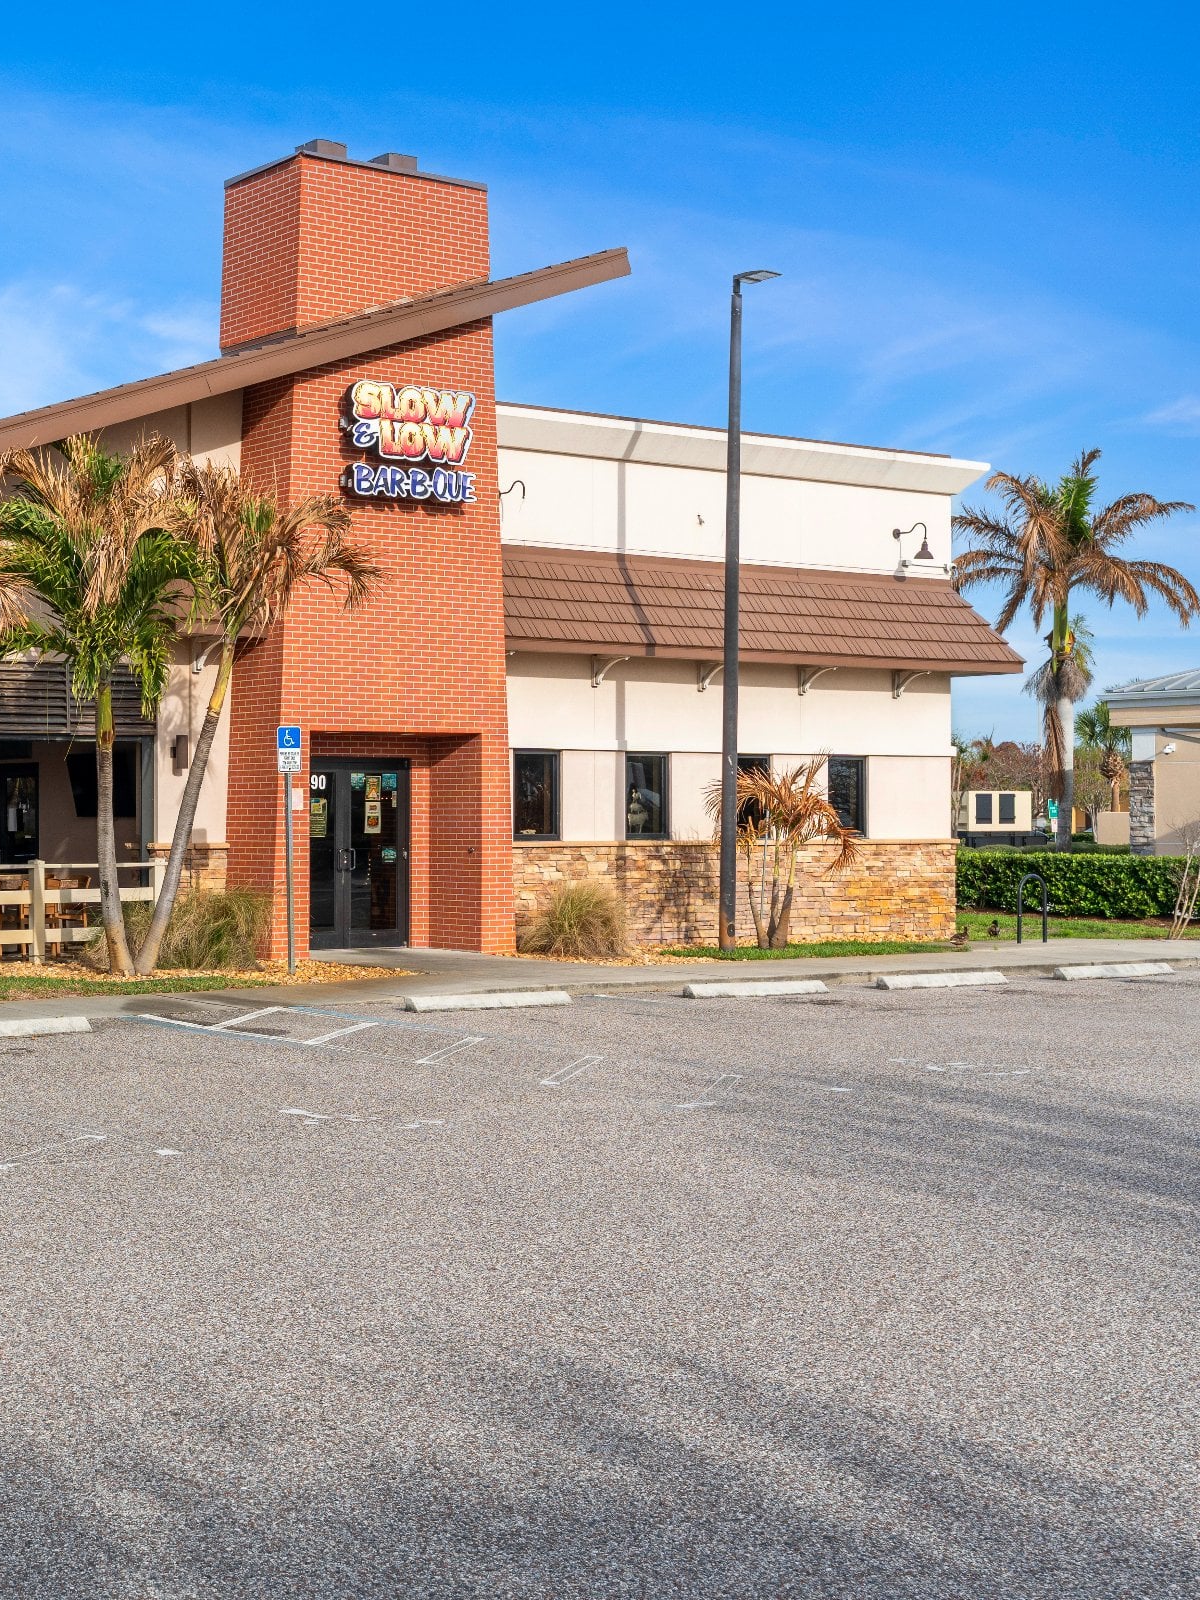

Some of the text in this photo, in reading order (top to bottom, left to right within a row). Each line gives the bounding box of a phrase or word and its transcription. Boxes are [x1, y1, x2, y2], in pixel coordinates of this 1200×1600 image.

[353, 381, 473, 428] SLOW
[353, 419, 469, 463] & LOW
[353, 463, 477, 502] BAR-B-QUE
